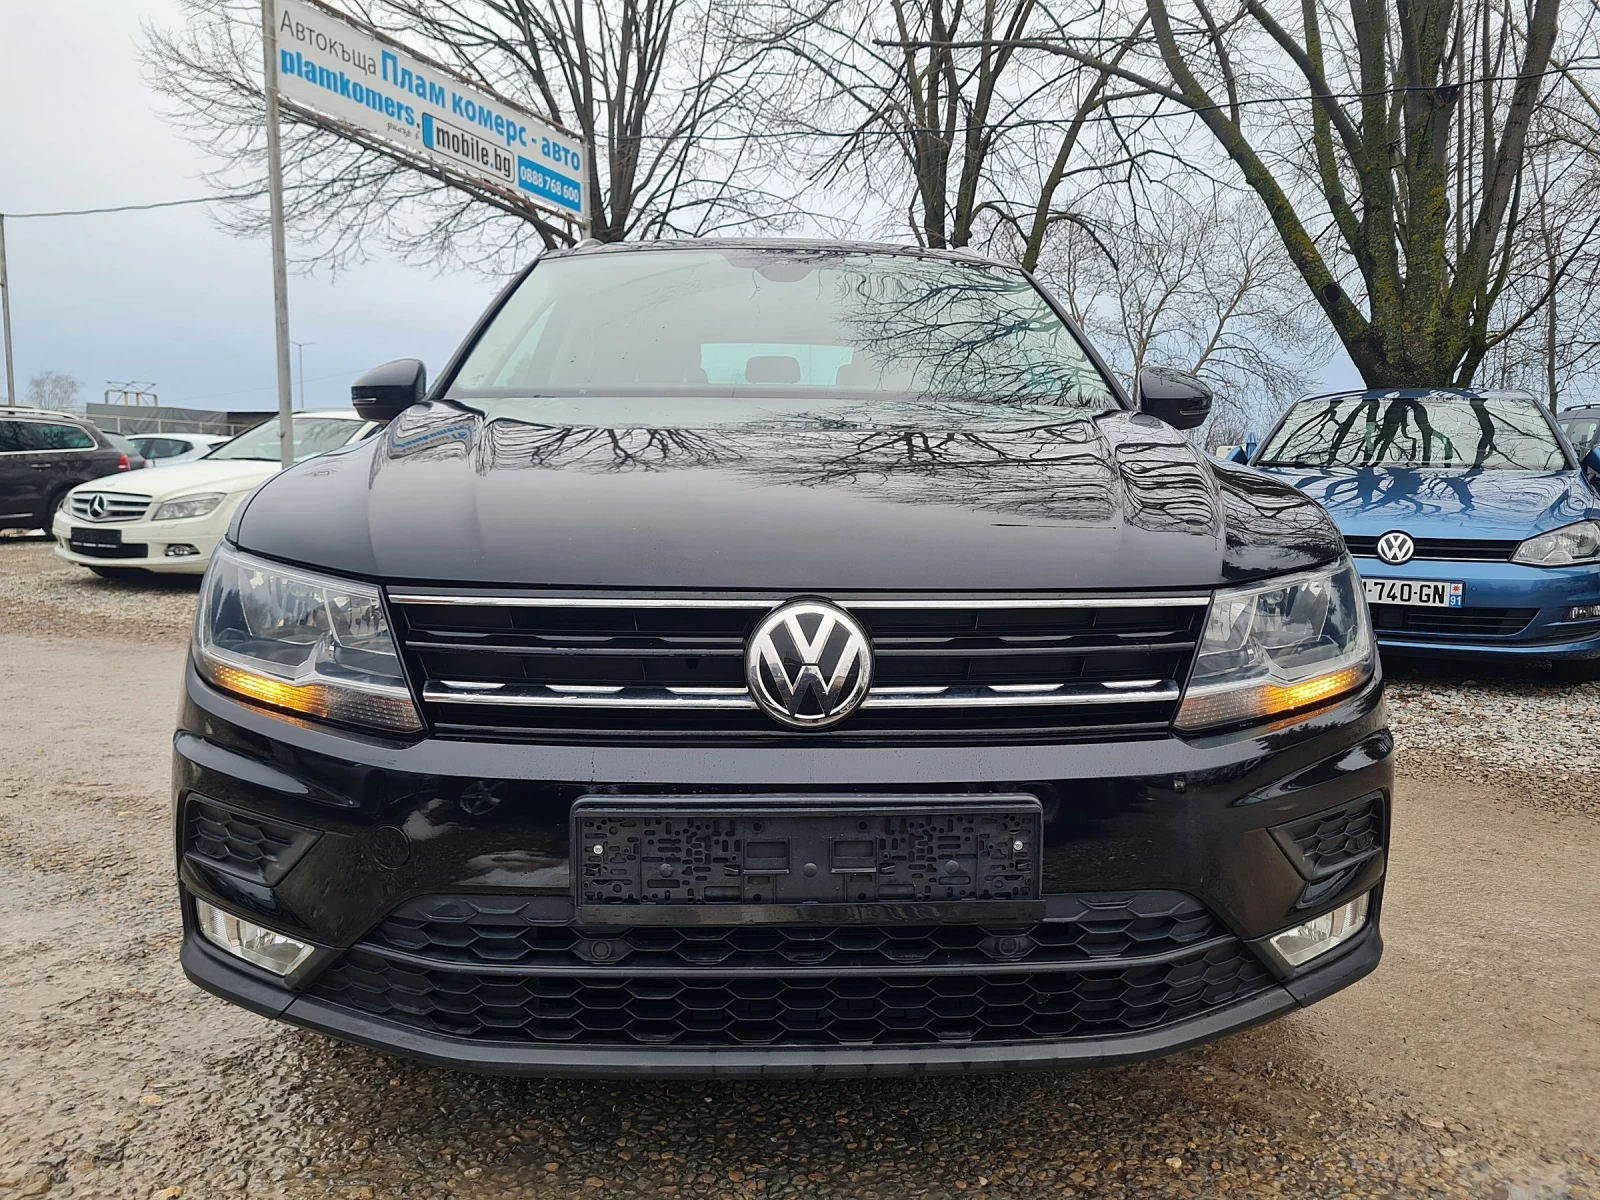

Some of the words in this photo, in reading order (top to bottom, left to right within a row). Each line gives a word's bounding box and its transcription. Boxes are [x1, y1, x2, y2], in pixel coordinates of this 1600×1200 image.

[280, 10, 377, 76] Автокъща
[381, 49, 446, 109] Плам
[451, 92, 527, 147] комерс
[541, 136, 580, 171] авто
[436, 126, 511, 178] mobile.bg
[520, 165, 544, 188] 0888
[544, 175, 562, 196] 768
[562, 184, 580, 203] 600
[1450, 596, 1461, 606] 91
